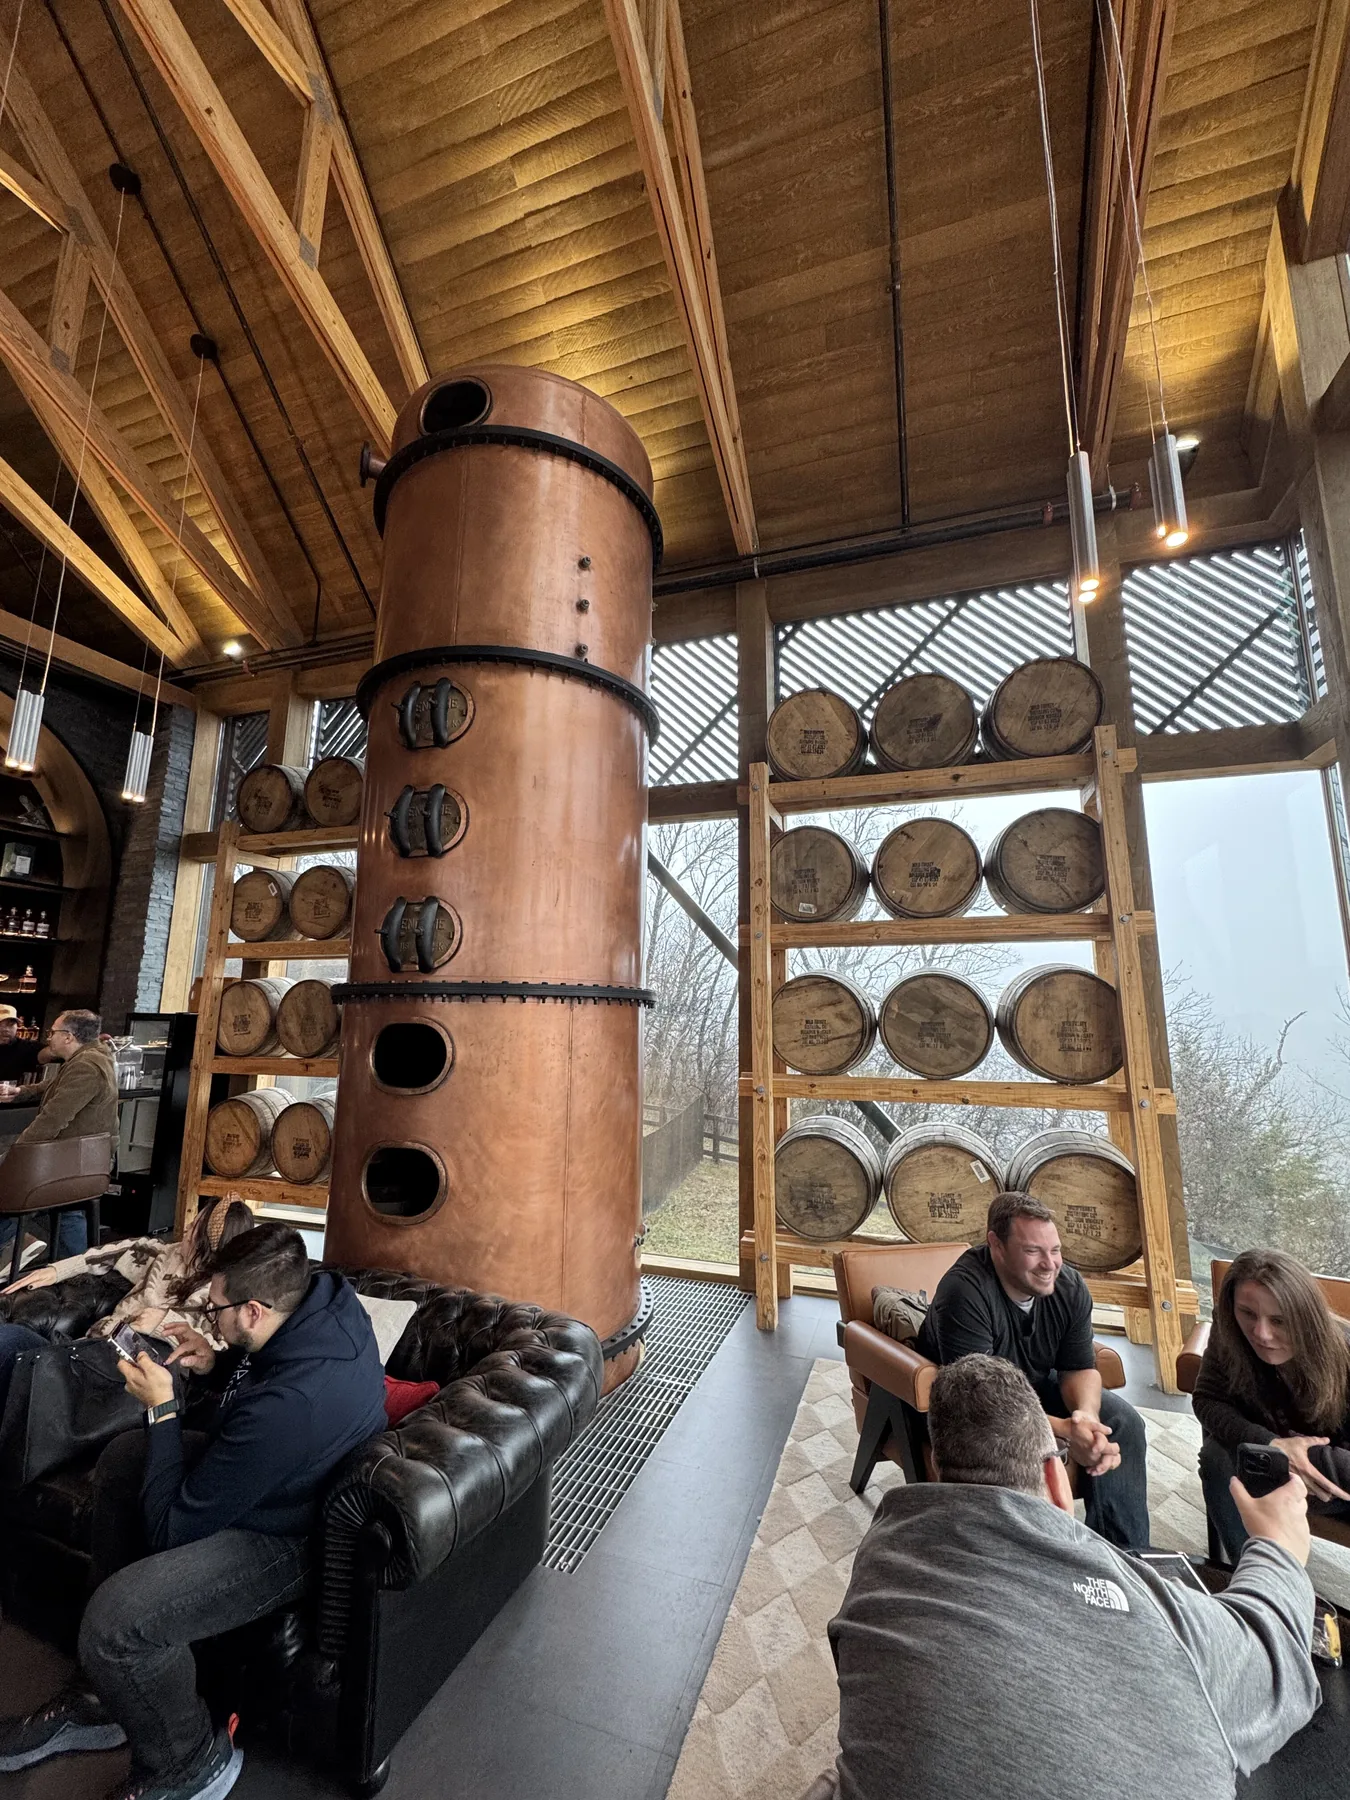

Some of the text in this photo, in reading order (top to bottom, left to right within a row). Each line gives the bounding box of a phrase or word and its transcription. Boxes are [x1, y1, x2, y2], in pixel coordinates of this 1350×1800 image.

[1073, 1581, 1109, 1598] NORTH
[1086, 1576, 1107, 1589] THE
[1085, 1594, 1111, 1608] FACE
